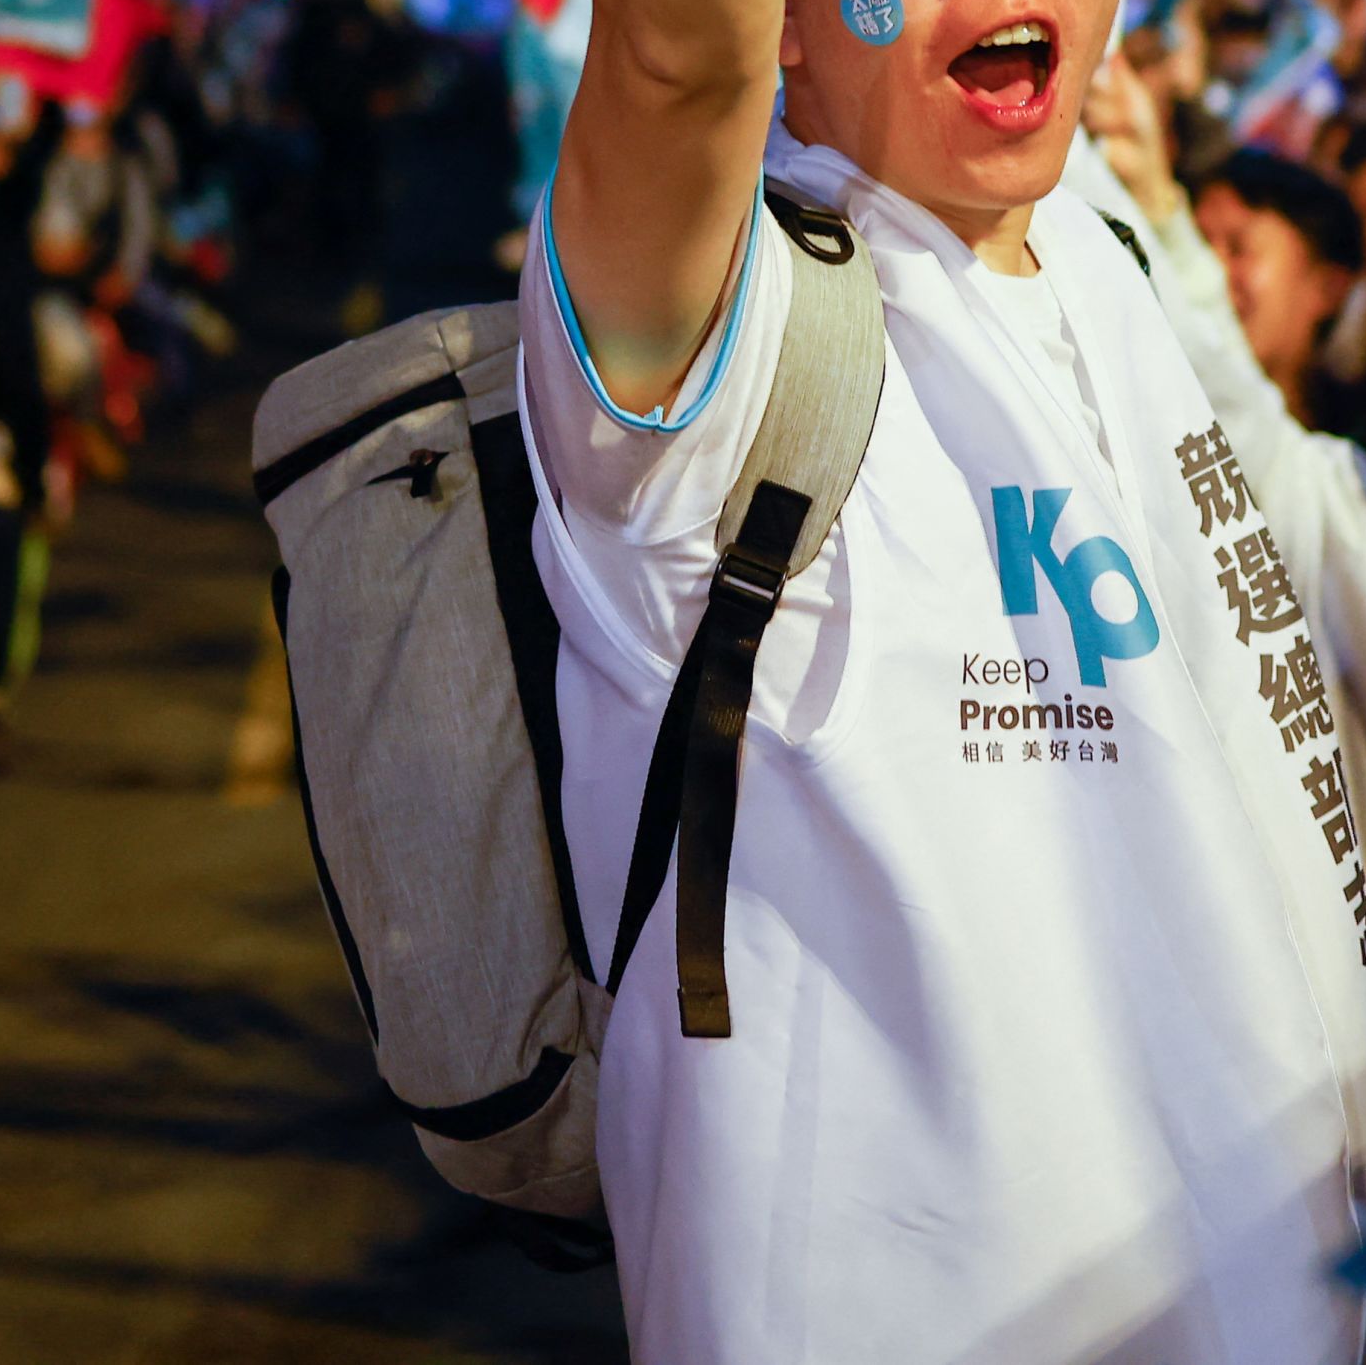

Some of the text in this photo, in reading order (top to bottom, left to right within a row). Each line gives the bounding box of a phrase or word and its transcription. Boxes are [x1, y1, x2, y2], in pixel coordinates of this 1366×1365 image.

[991, 486, 1160, 688] Kp
[962, 653, 1049, 694] Keep
[960, 693, 1114, 730] Promise
